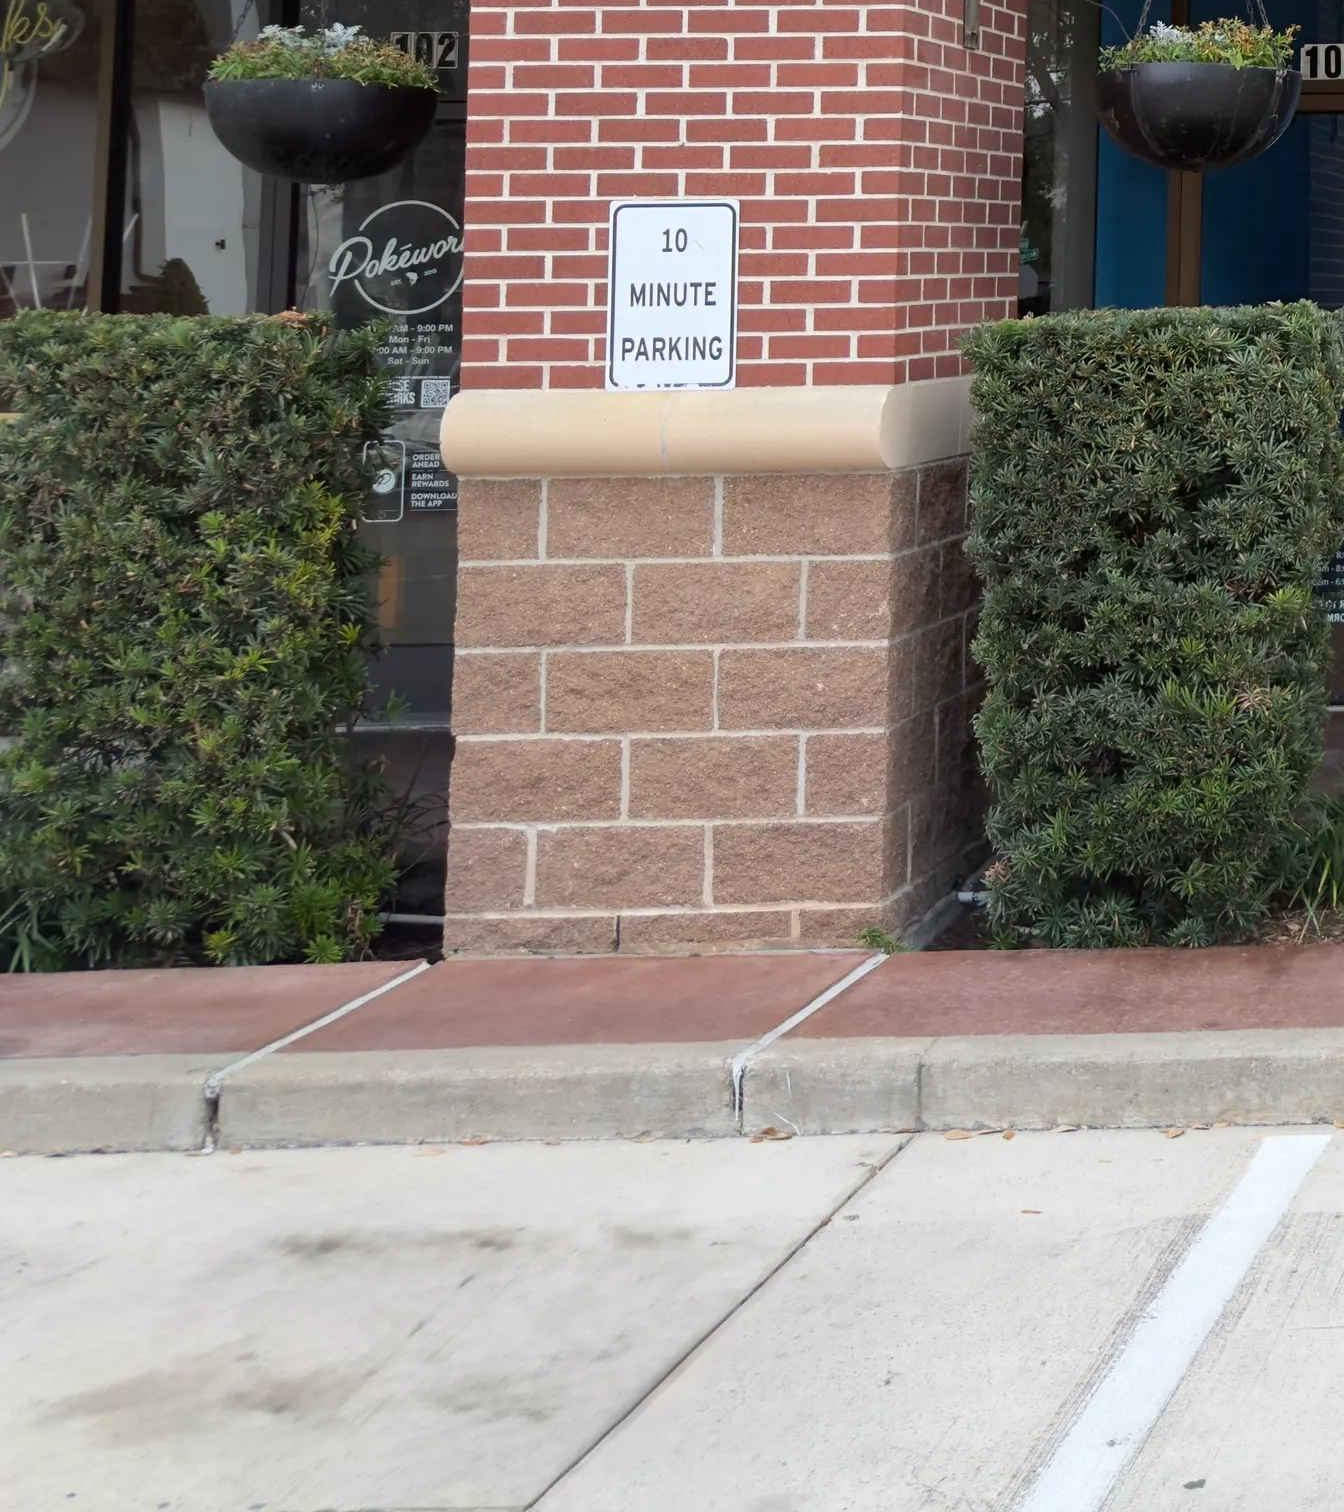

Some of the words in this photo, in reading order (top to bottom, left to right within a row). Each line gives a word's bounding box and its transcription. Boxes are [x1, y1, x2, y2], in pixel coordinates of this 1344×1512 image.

[661, 228, 688, 253] 10
[328, 236, 465, 298] Pokéwor
[630, 282, 717, 307] MINUTE
[417, 324, 437, 333] 9:00
[438, 324, 454, 332] PM
[389, 335, 410, 343] Mon
[418, 335, 431, 343] Fri
[391, 346, 408, 354] AM
[416, 346, 435, 354] 9:00
[437, 346, 453, 354] PM
[621, 336, 723, 362] PARKING
[387, 356, 403, 365] Sat
[411, 356, 430, 365] Sun
[411, 480, 450, 488] REWARDS
[411, 492, 457, 500] DOWNLOAD
